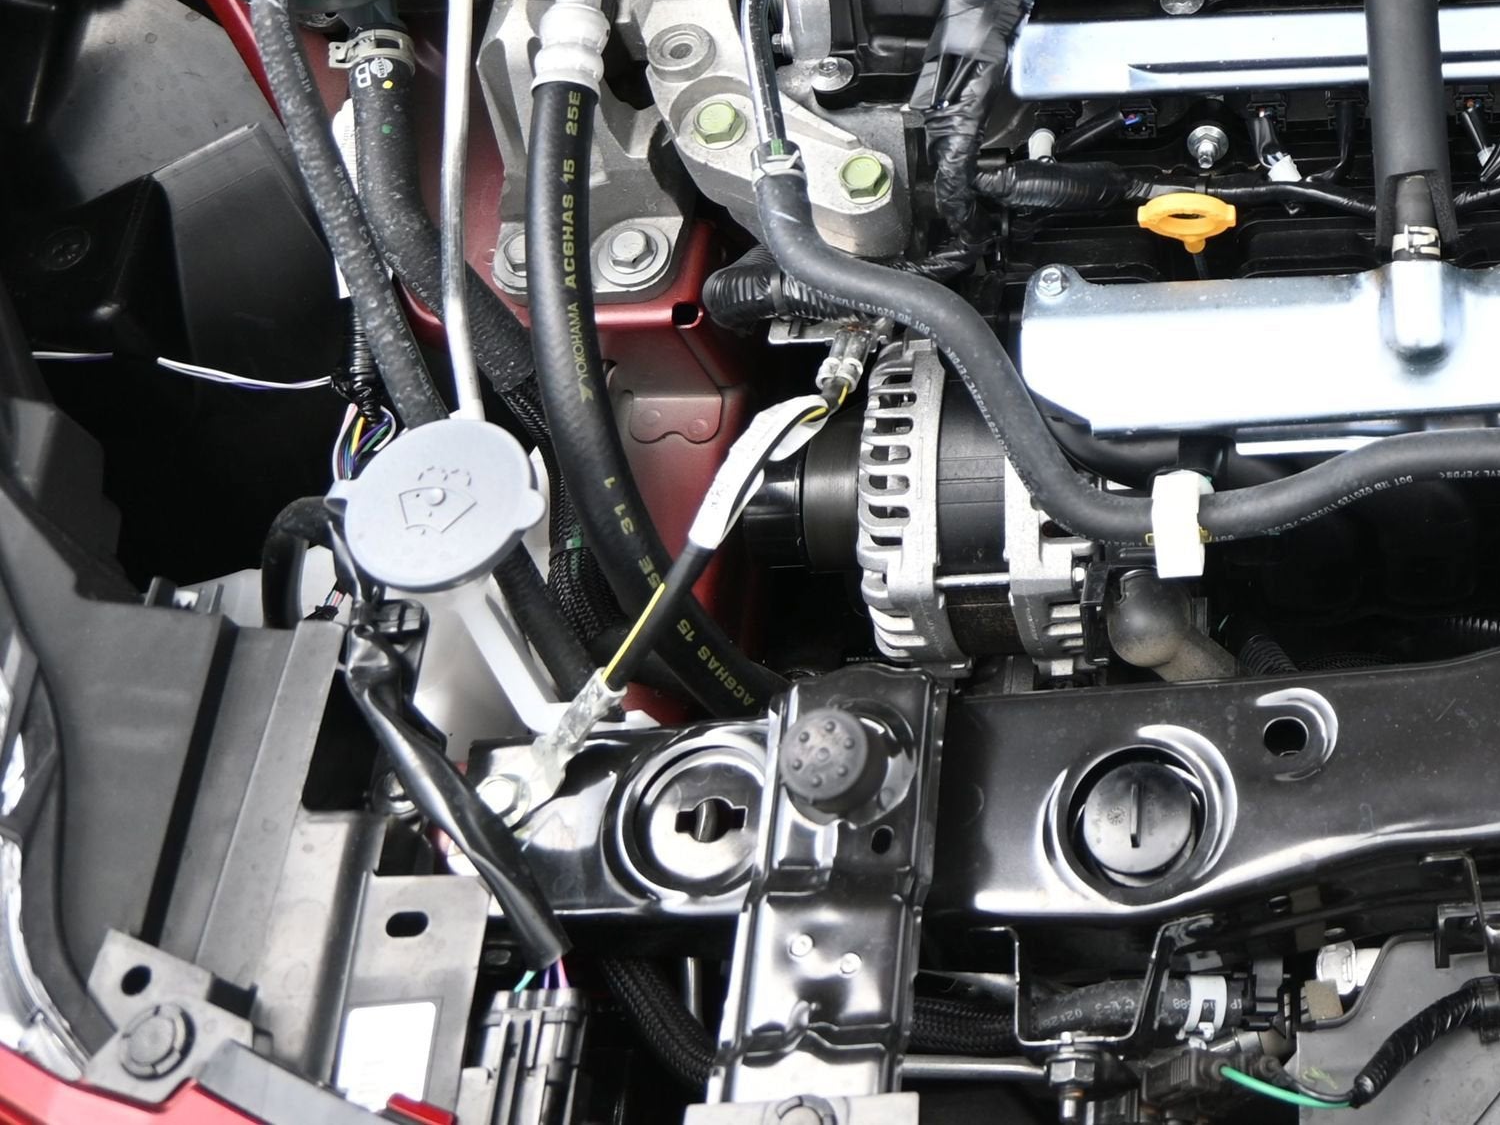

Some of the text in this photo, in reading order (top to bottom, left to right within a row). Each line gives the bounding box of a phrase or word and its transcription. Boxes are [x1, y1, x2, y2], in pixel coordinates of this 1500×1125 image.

[566, 91, 581, 135] 25E
[563, 159, 575, 184] 15
[567, 302, 589, 381] YOKOHAMA
[639, 556, 660, 589] 5E
[677, 618, 700, 643] 15
